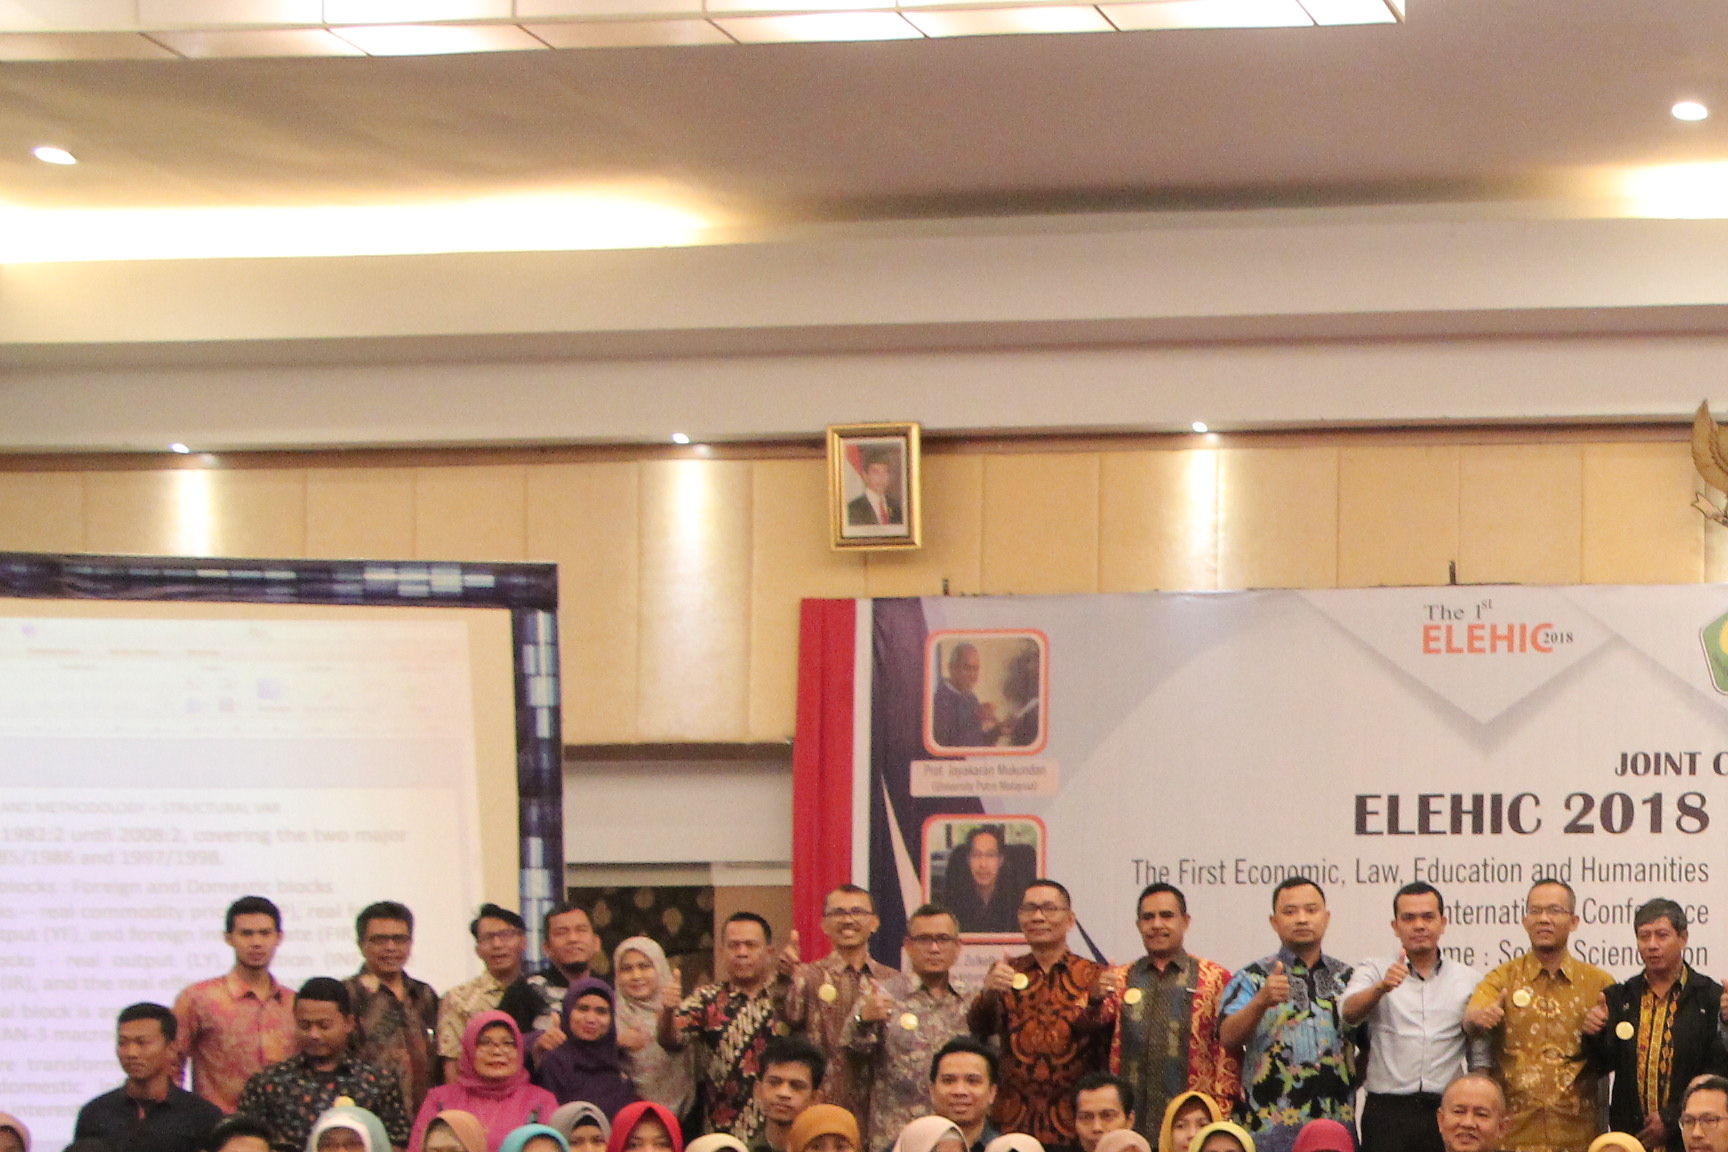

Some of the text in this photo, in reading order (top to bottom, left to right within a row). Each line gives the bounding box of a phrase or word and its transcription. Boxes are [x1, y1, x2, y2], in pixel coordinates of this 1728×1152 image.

[1423, 604, 1464, 620] The
[1423, 623, 1554, 654] ELEHIC
[1543, 632, 1574, 643] 2018
[1614, 751, 1702, 777] JOINT
[1354, 791, 1711, 836] ELEHIC 2018
[1132, 858, 1169, 885] The
[1179, 858, 1225, 885] First
[1235, 858, 1345, 888] Economic,
[1356, 858, 1403, 886] Law,
[1414, 856, 1522, 884] Education
[1581, 858, 1709, 884] Humanities
